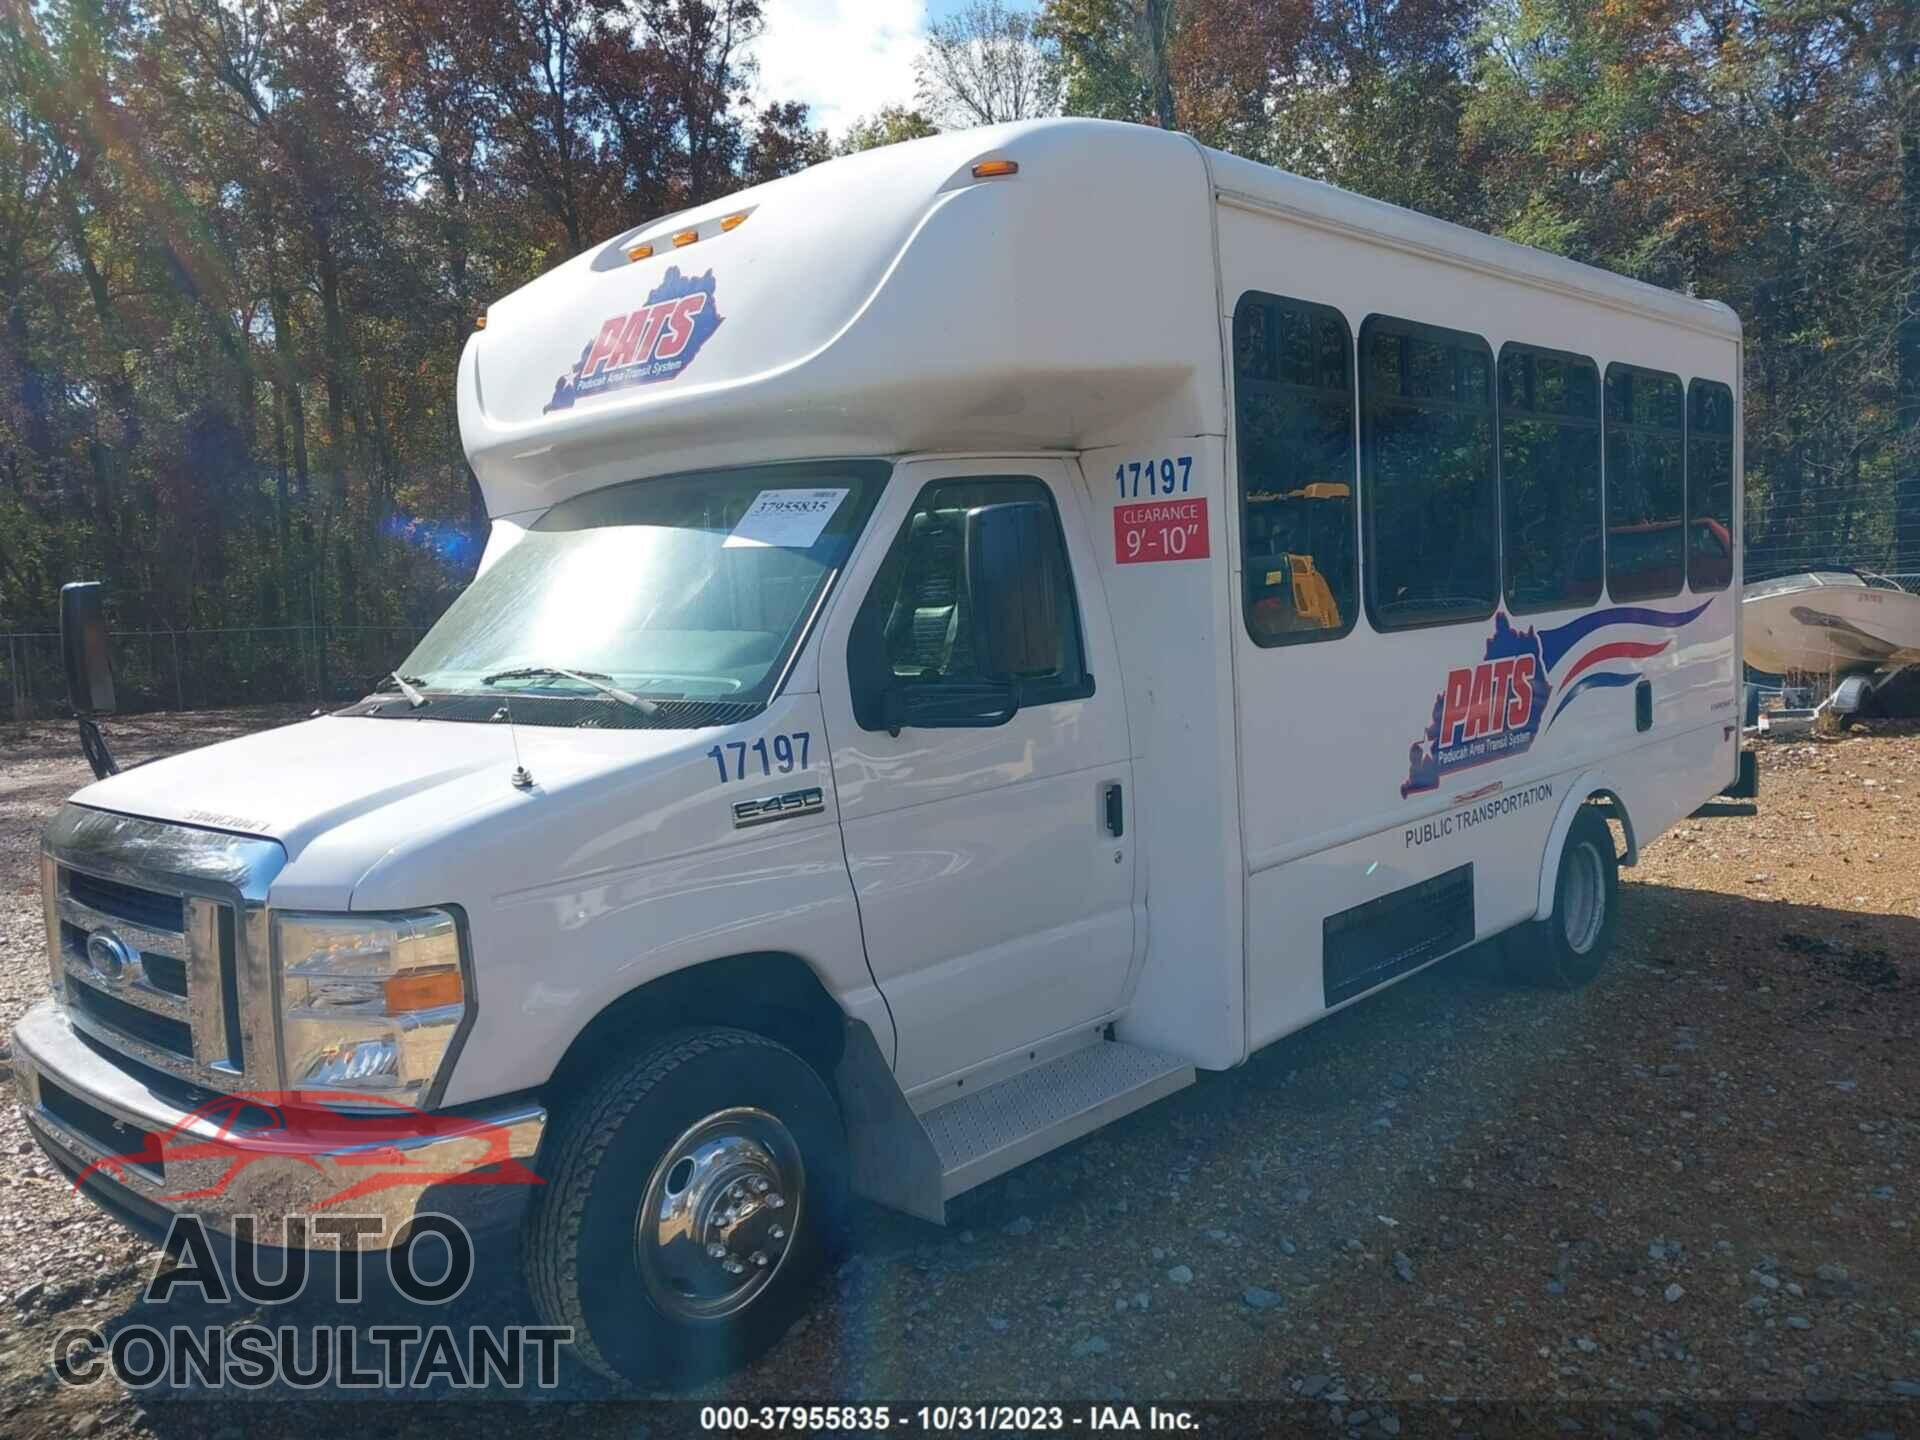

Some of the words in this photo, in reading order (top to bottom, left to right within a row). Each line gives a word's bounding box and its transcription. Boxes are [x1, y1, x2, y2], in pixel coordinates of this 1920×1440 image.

[581, 292, 706, 378] PATS
[652, 361, 682, 375] System
[1115, 456, 1193, 499] 17197
[1122, 504, 1200, 525] CLEARANCE
[1438, 653, 1536, 748] PATS
[707, 731, 810, 783] 17197
[1405, 816, 1453, 849] PUBLIC
[1455, 783, 1553, 831] TRANSPORTATION
